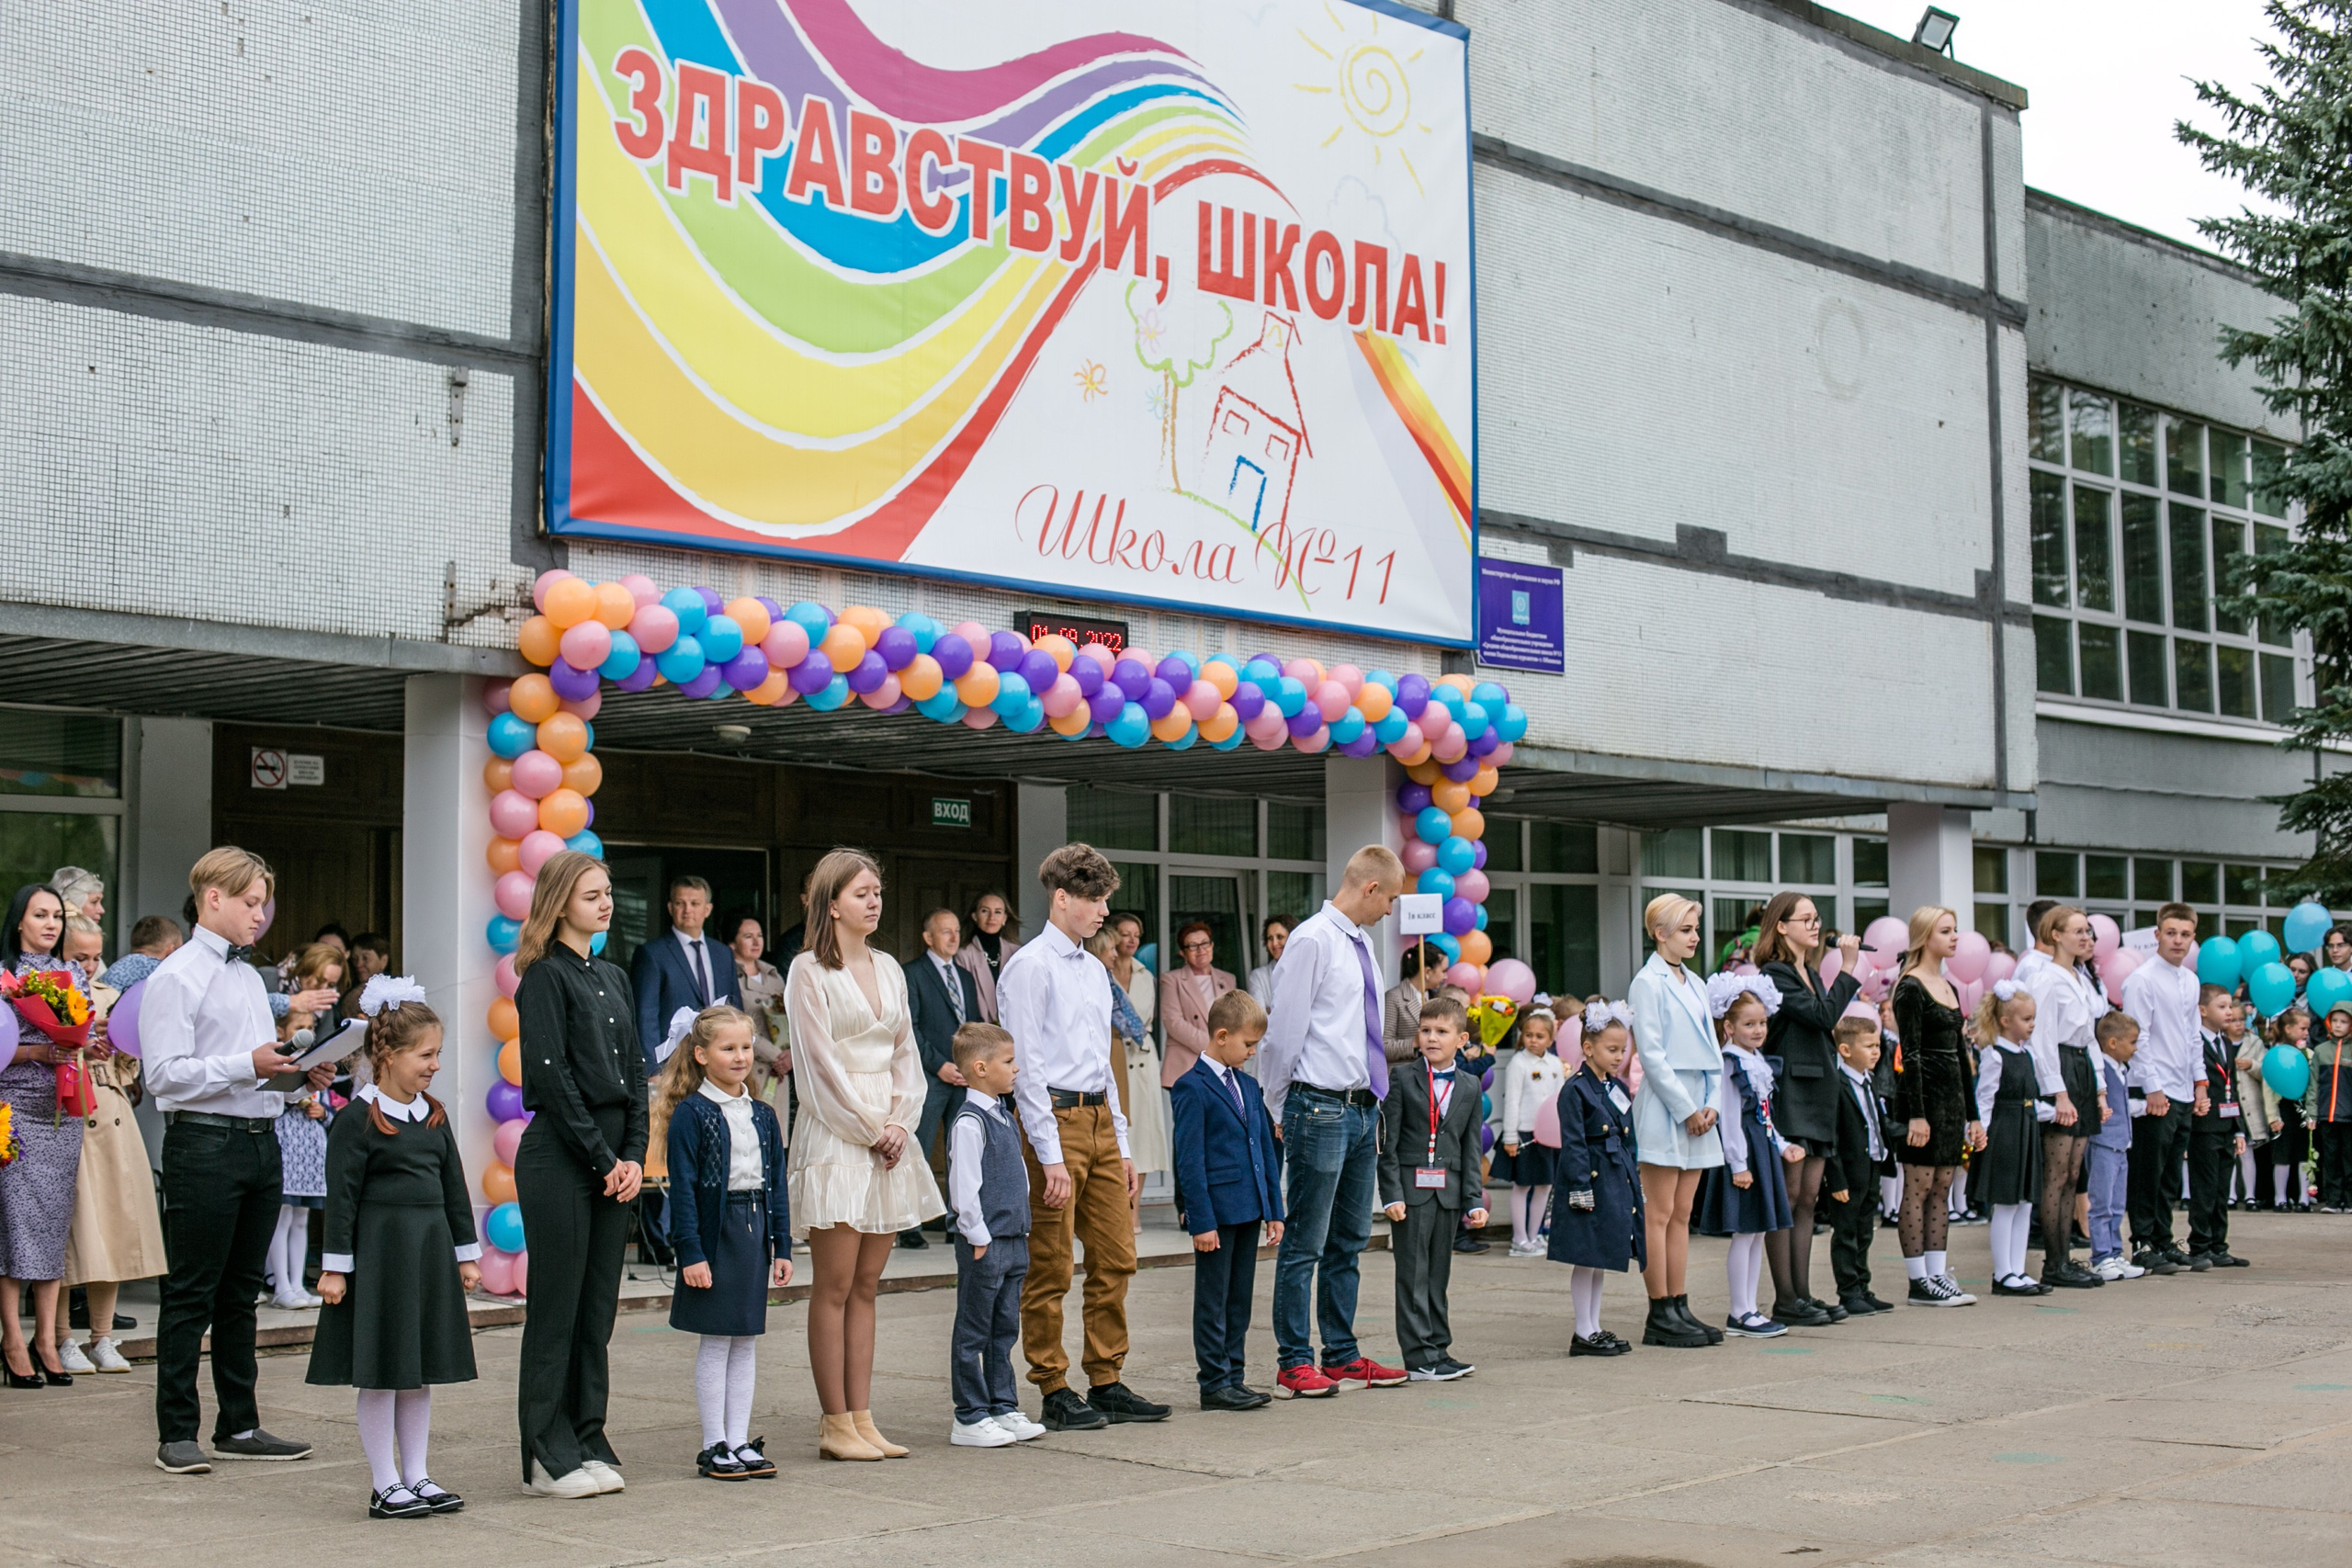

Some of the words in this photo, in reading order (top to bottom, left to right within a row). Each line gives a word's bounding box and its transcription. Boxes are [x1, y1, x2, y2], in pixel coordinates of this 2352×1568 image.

[612, 49, 1170, 305] ЗДРАВСТВУЙ,
[1197, 199, 1446, 345] ШКОЛА!
[1015, 484, 1244, 584] Школа
[1255, 522, 1396, 604] №11
[934, 802, 968, 822] ВХОД
